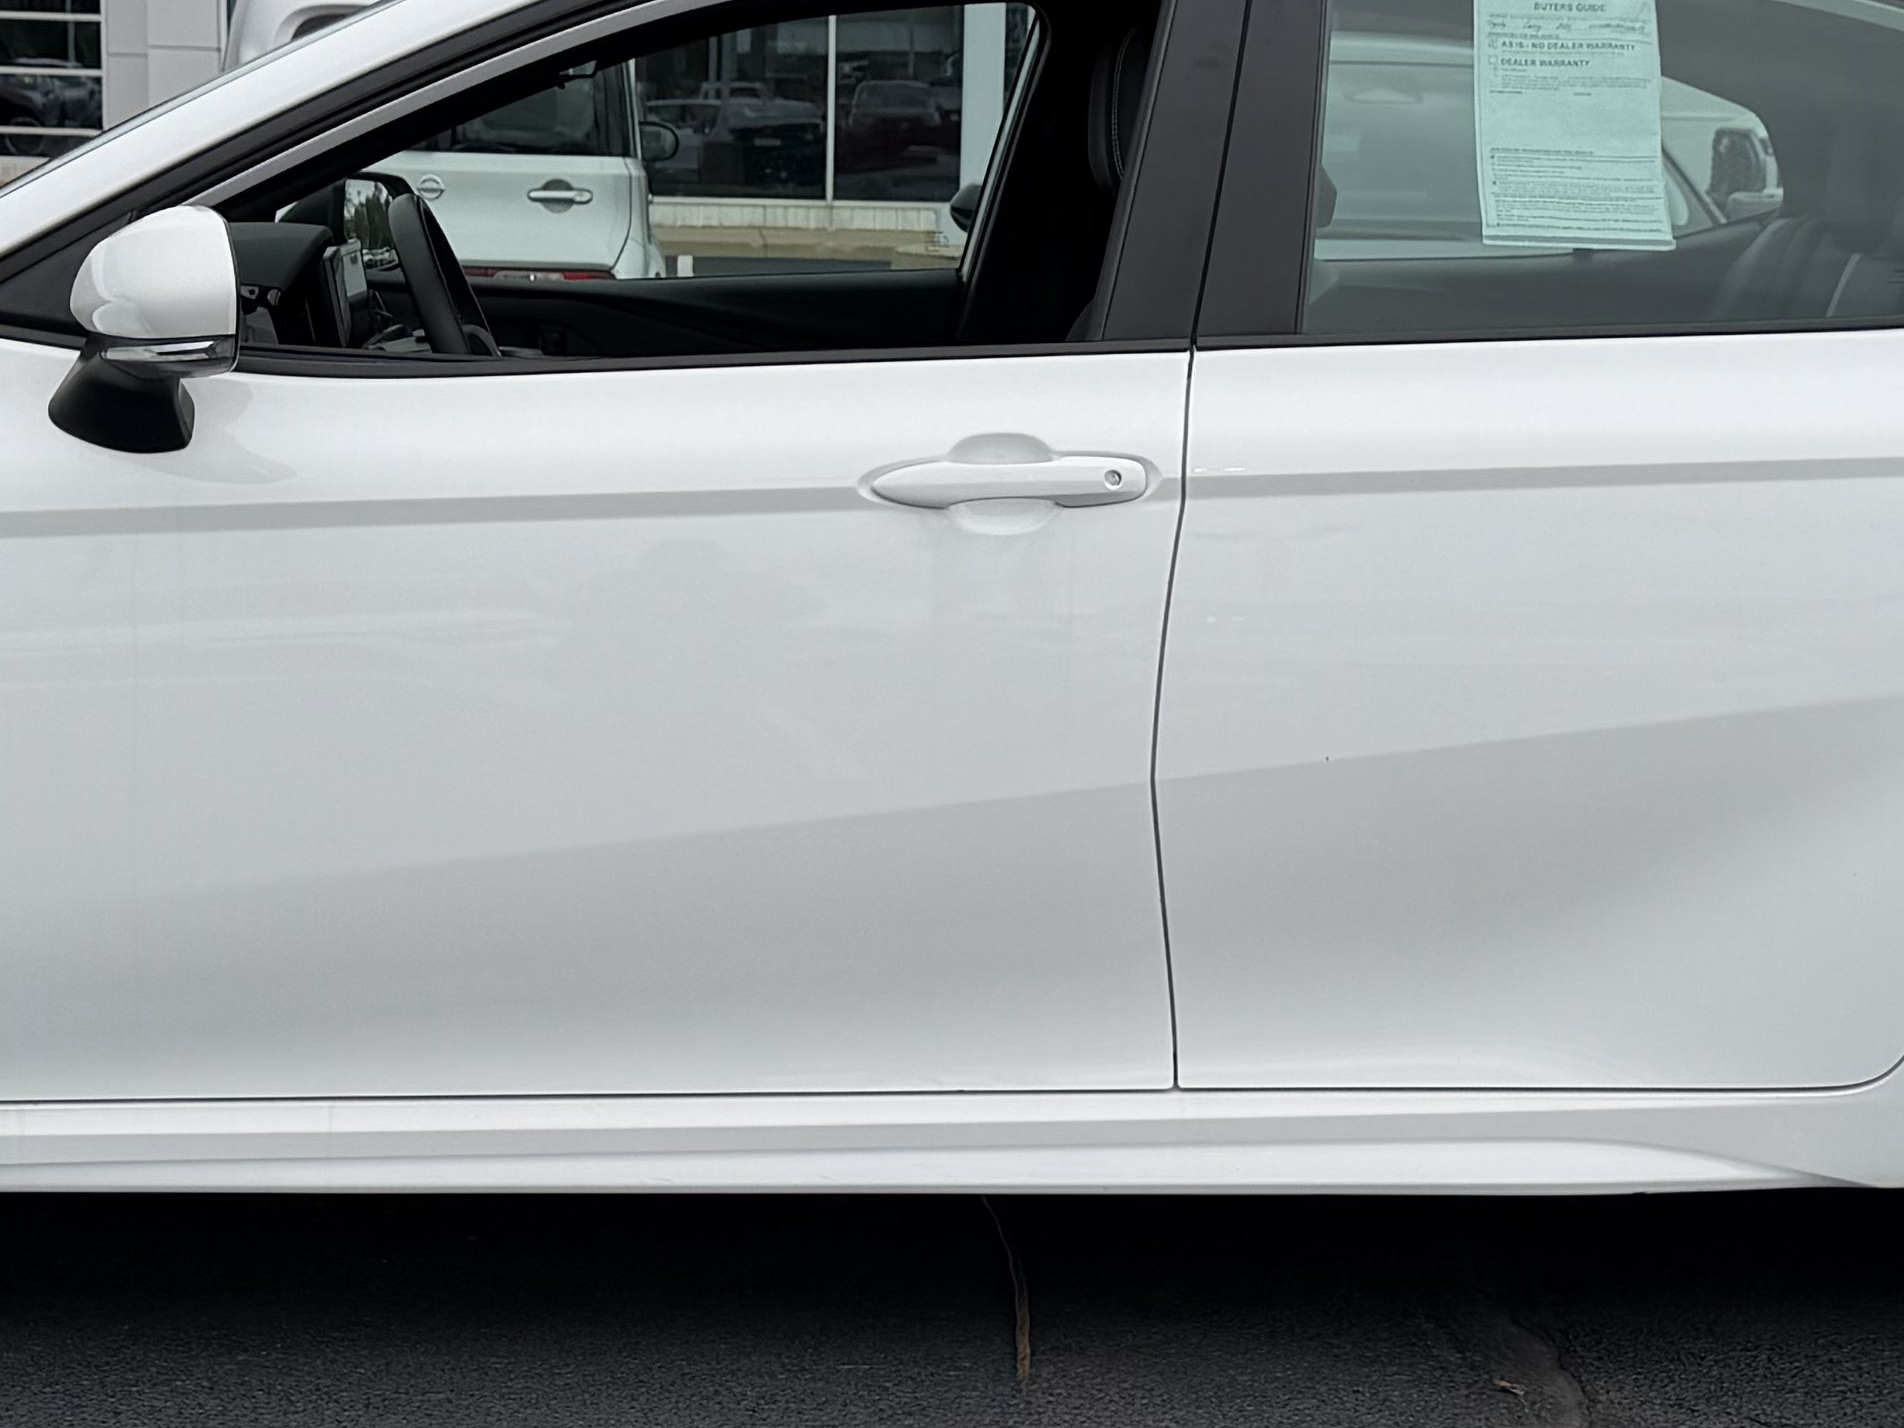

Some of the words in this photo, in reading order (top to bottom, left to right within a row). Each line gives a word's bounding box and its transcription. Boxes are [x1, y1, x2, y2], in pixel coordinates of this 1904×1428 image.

[1575, 2, 1607, 13] GUIDE
[1531, 41, 1545, 50] NO
[1546, 42, 1583, 50] DEALER
[1586, 42, 1635, 51] WARRANTY
[1500, 58, 1536, 67] DEALER
[1539, 59, 1590, 68] WARRANTY
